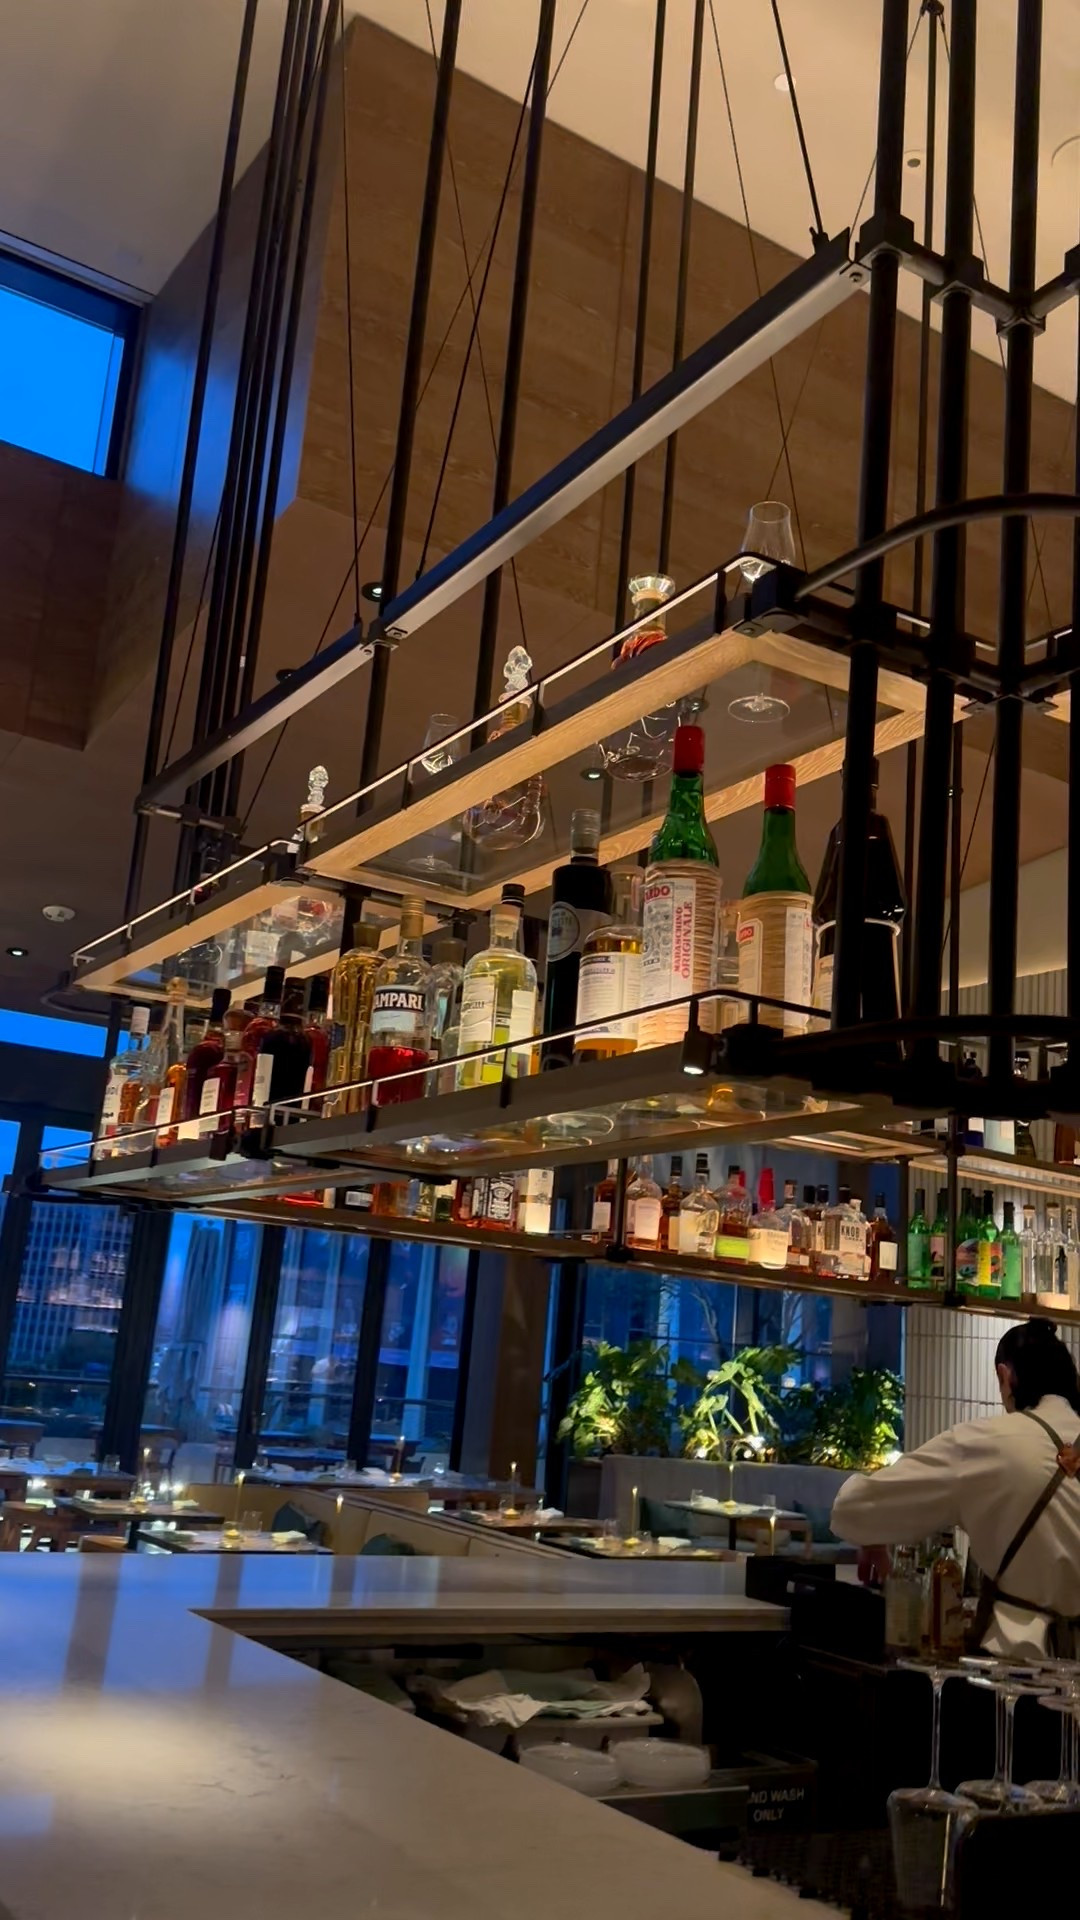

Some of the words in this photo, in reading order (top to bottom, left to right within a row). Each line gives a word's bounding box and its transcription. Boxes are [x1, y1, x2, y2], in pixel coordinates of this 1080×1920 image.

[681, 901, 692, 978] ORIGINALE
[374, 992, 423, 1011] AMPARI
[841, 1225, 860, 1239] KNOB
[748, 1790, 768, 1804] ND
[770, 1787, 805, 1802] WASH
[753, 1807, 784, 1824] ONLY
